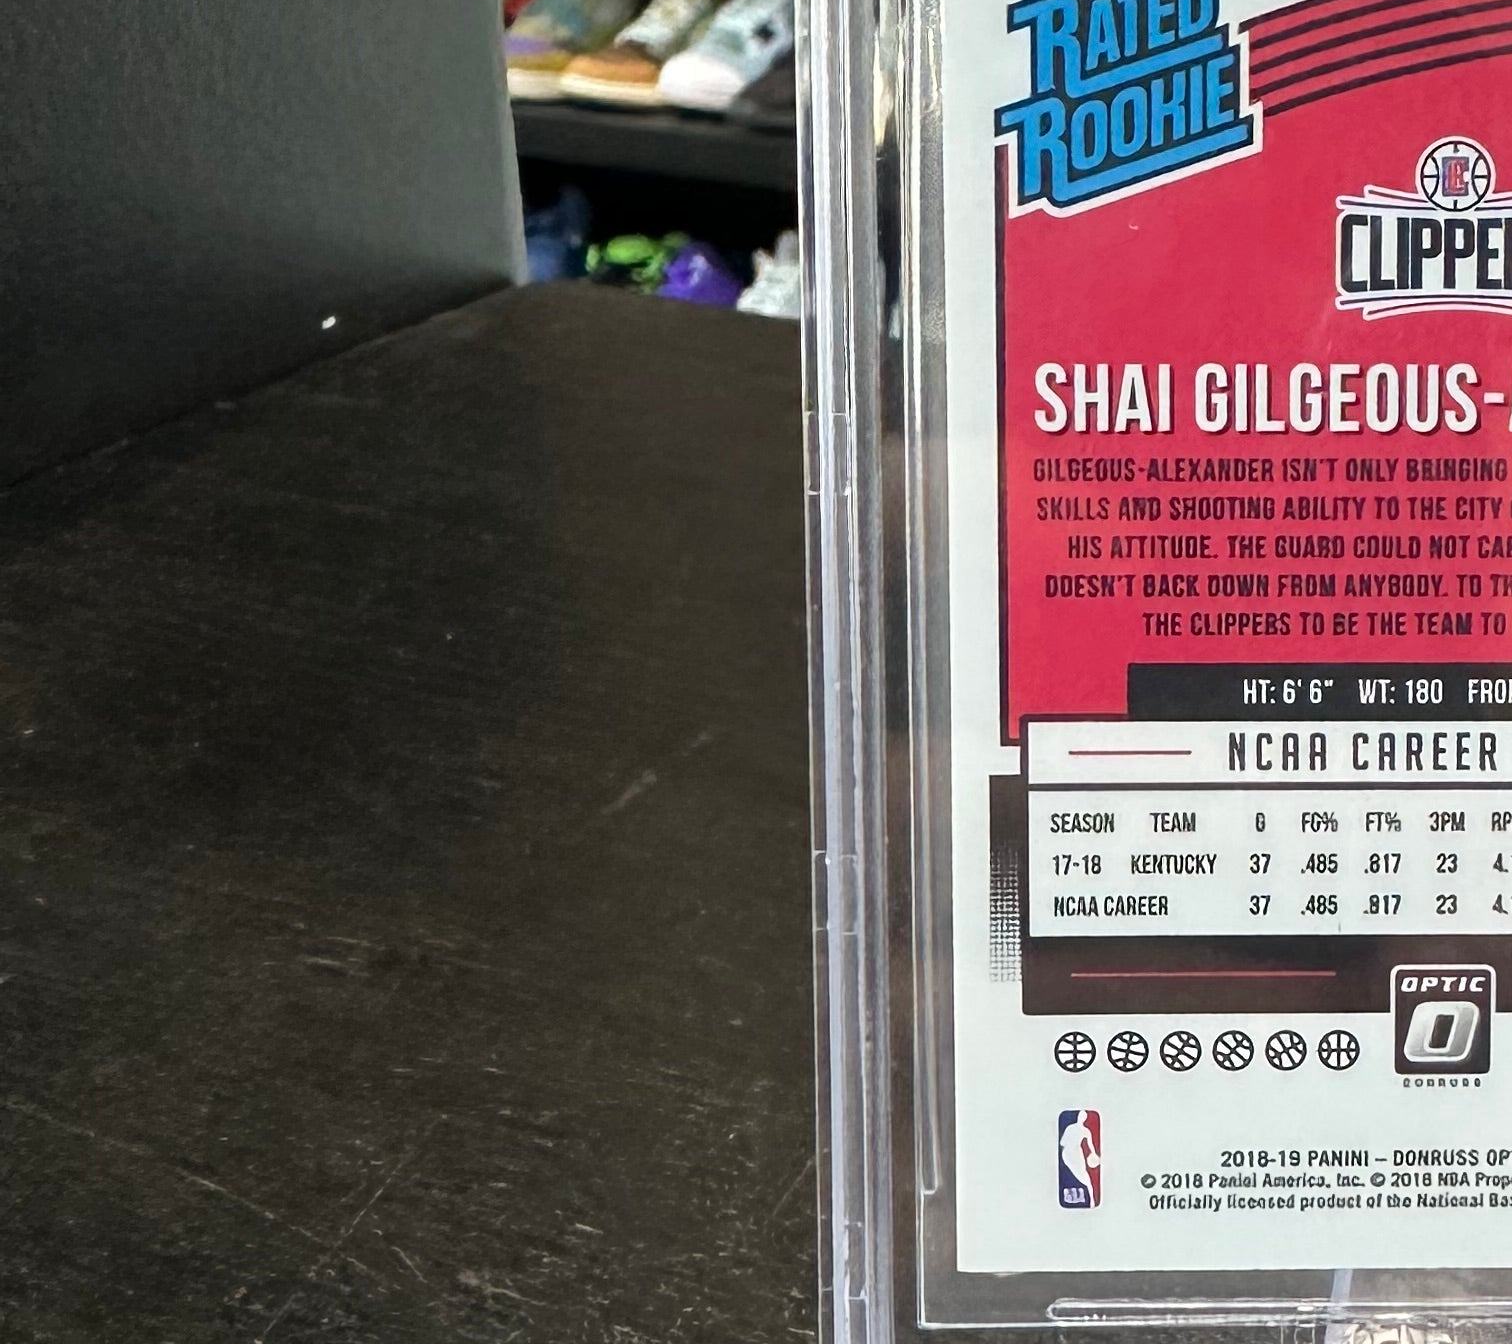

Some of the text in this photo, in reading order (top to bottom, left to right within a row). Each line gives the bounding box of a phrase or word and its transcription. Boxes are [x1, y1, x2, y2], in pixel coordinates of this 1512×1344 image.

[1000, 52, 1250, 203] ROOKIE
[1033, 361, 1172, 434] SHAI
[1033, 457, 1274, 483] GILGEOUS-ALEXANDER
[1281, 457, 1339, 483] ISN'T
[1345, 457, 1399, 483] ONLY
[1405, 457, 1508, 483] BRINGING
[1037, 496, 1111, 521] SKILLS
[1118, 496, 1162, 522] AND
[1168, 495, 1276, 522] SHOOTING
[1282, 495, 1367, 521] ABILITY
[1374, 495, 1400, 521] TO
[1406, 496, 1448, 521] THE
[1455, 495, 1503, 521] CITY
[1068, 535, 1102, 560] HIS
[1110, 534, 1219, 560] ATTITUDE.
[1226, 534, 1267, 559] THE
[1274, 534, 1345, 559] GUARD
[1352, 535, 1422, 560] COULD
[1428, 534, 1471, 560] NOT
[1045, 574, 1137, 598] DOESN'T
[1142, 573, 1201, 598] BACK
[1207, 573, 1270, 598] DOWN
[1277, 573, 1337, 598] FROM
[1344, 573, 1449, 598] ANYBODY.
[1455, 573, 1482, 598] TO
[1142, 612, 1183, 637] THE
[1190, 611, 1291, 637] CLIPPERS
[1299, 611, 1325, 636] TO
[1332, 612, 1359, 637] BE
[1366, 611, 1408, 637] THE
[1414, 611, 1473, 636] TEAM
[1480, 612, 1507, 636] TO
[1243, 678, 1276, 705] HT:
[1358, 678, 1396, 704] WT:
[1405, 678, 1443, 704] 180
[1227, 731, 1328, 773] NCAA
[1351, 730, 1499, 773] CAREER
[1049, 812, 1115, 834] SEASON
[1149, 811, 1197, 833] TEAM
[1301, 811, 1339, 833] FG%
[1365, 811, 1402, 833] FT%
[1428, 811, 1466, 833] 3PM
[1052, 854, 1102, 876] 17-18
[1130, 853, 1218, 875] KENTUCKY
[1249, 853, 1272, 875] 37
[1300, 852, 1339, 874] .485
[1364, 852, 1402, 874] .817
[1435, 852, 1458, 874] 23
[1053, 895, 1099, 918] NCAA
[1103, 895, 1169, 917] CAREER
[1248, 894, 1271, 916] 37
[1300, 894, 1338, 916] .485
[1363, 894, 1402, 916] .817
[1435, 894, 1458, 915] 23
[1400, 976, 1486, 993] OPTIC
[1220, 1150, 1301, 1168] 2018-19
[1307, 1149, 1369, 1168] PANINI
[1393, 1148, 1479, 1167] DONRUSS
[1366, 1192, 1383, 1209] of
